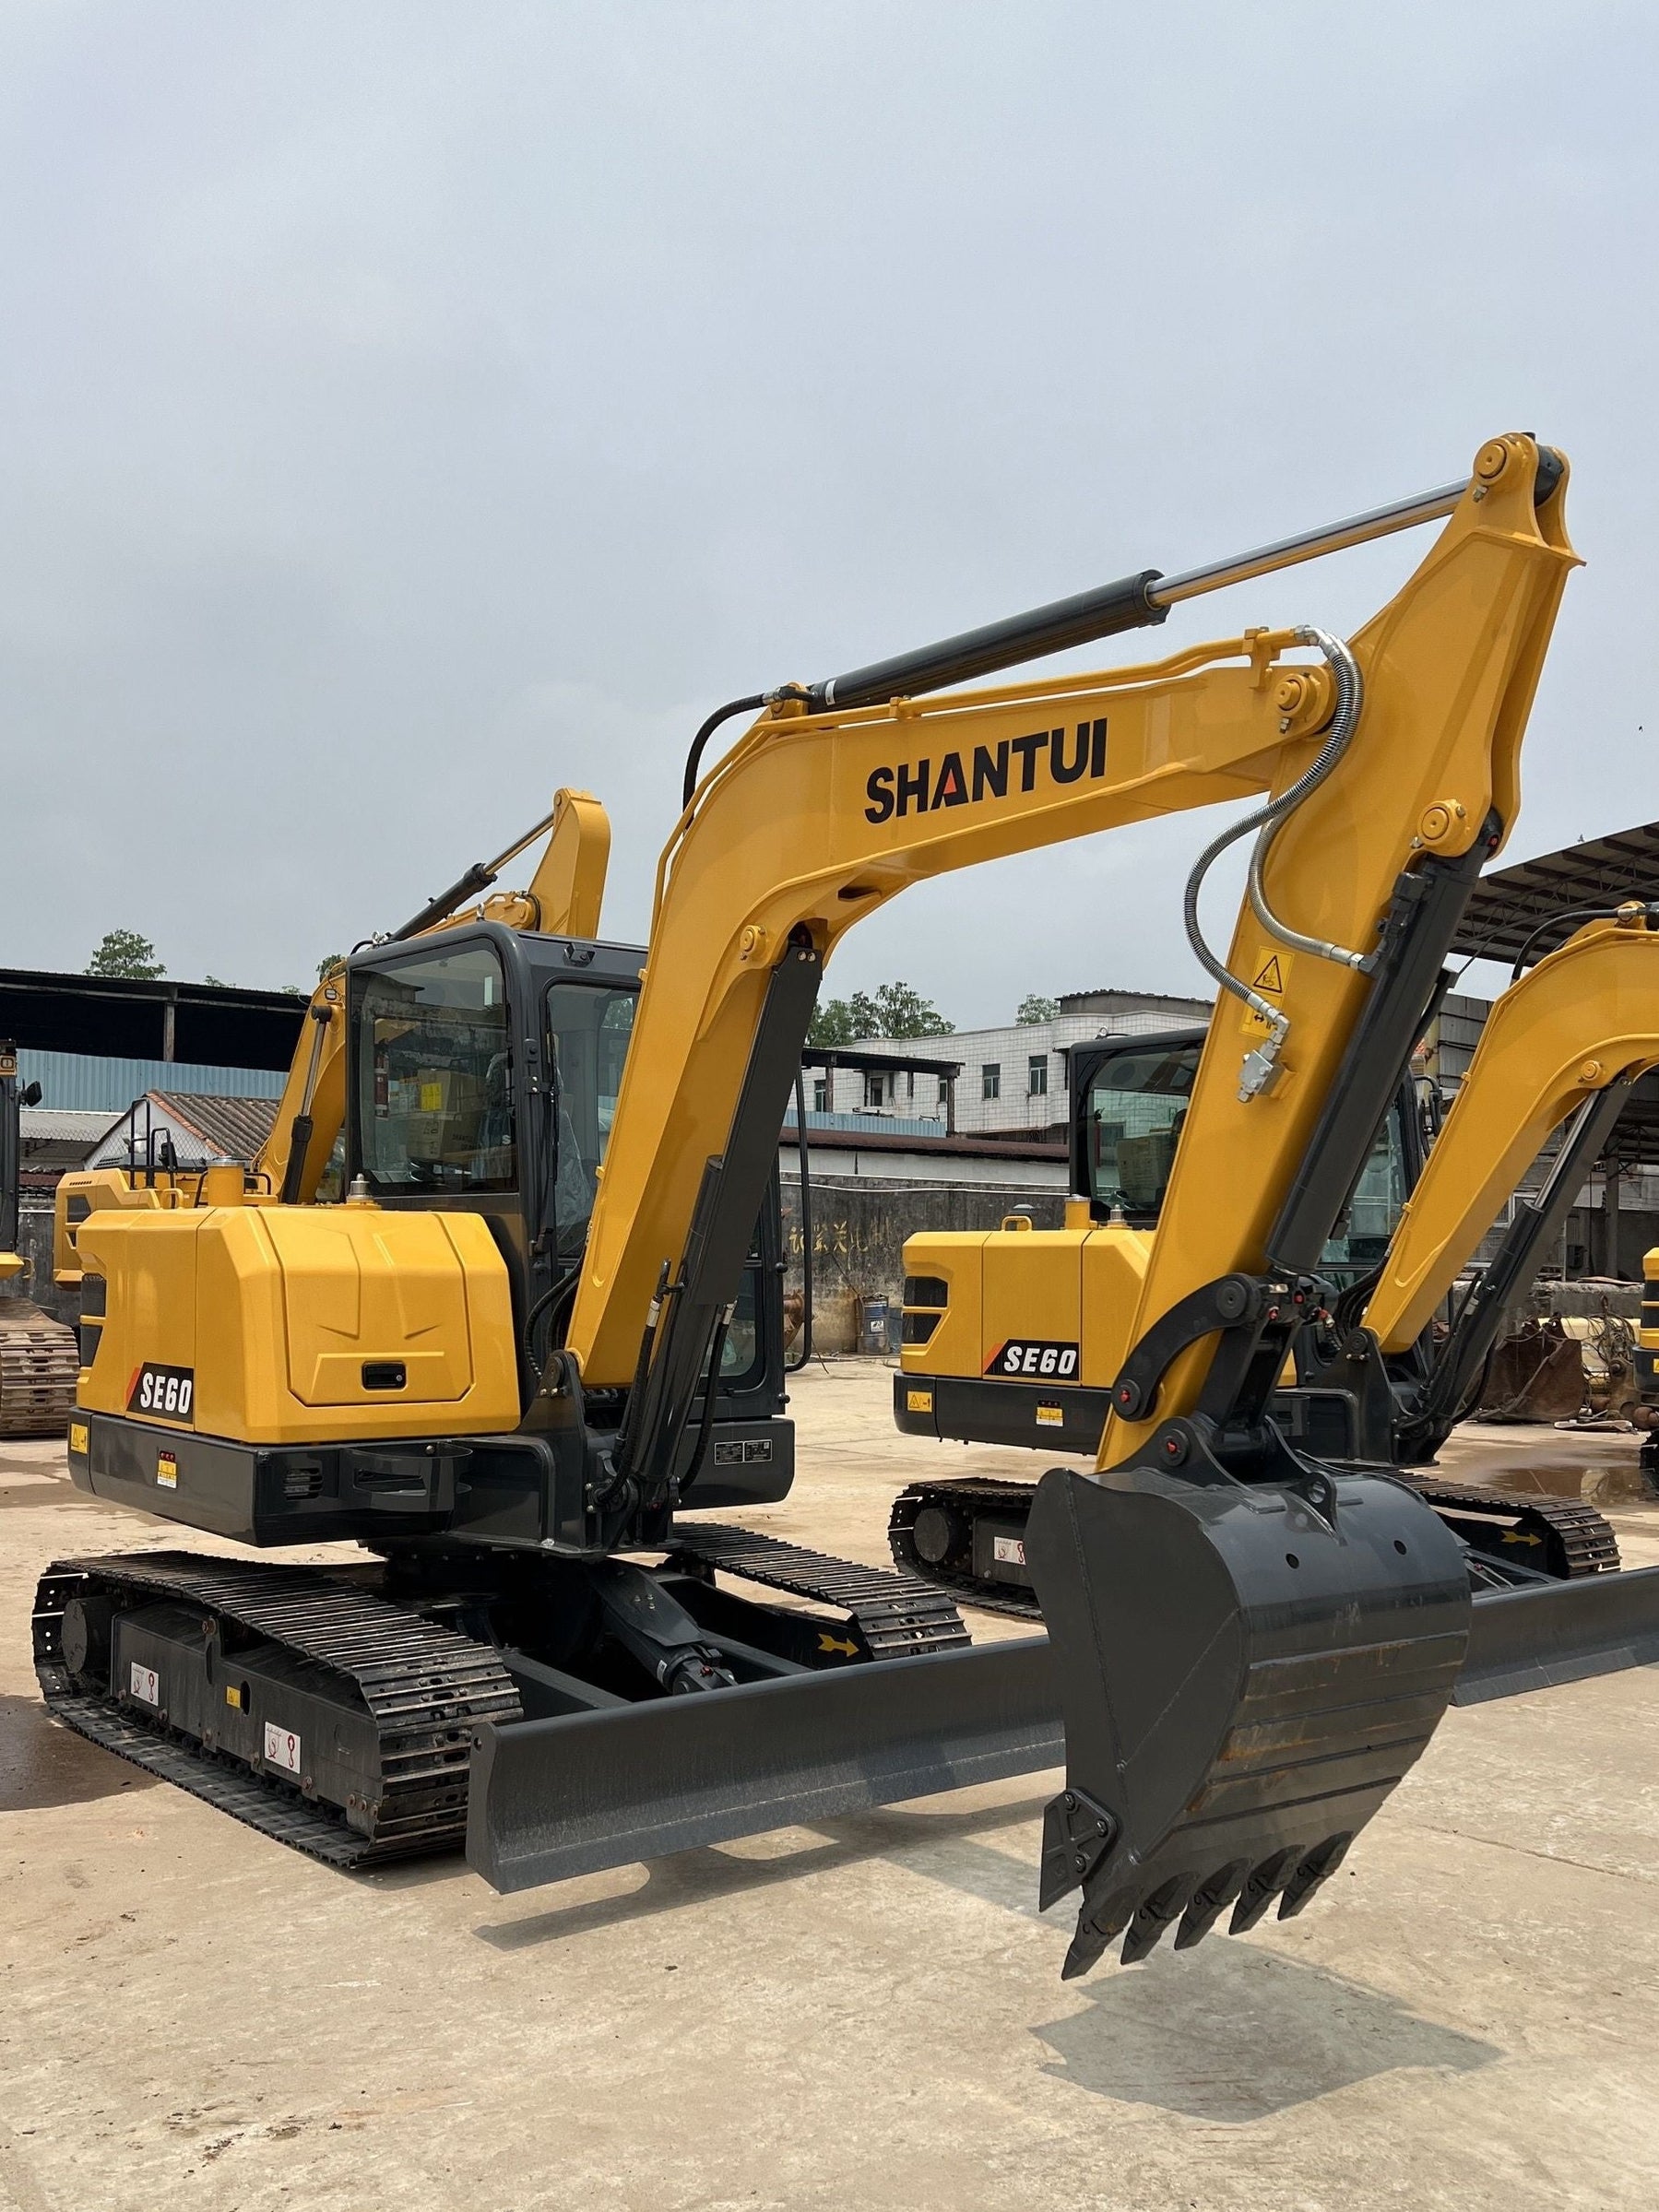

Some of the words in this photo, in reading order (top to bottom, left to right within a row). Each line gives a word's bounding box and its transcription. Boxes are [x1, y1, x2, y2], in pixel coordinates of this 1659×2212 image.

[864, 717, 1108, 824] SHANTUI
[1003, 1345, 1077, 1375] SE60
[139, 1372, 193, 1414] SE60
